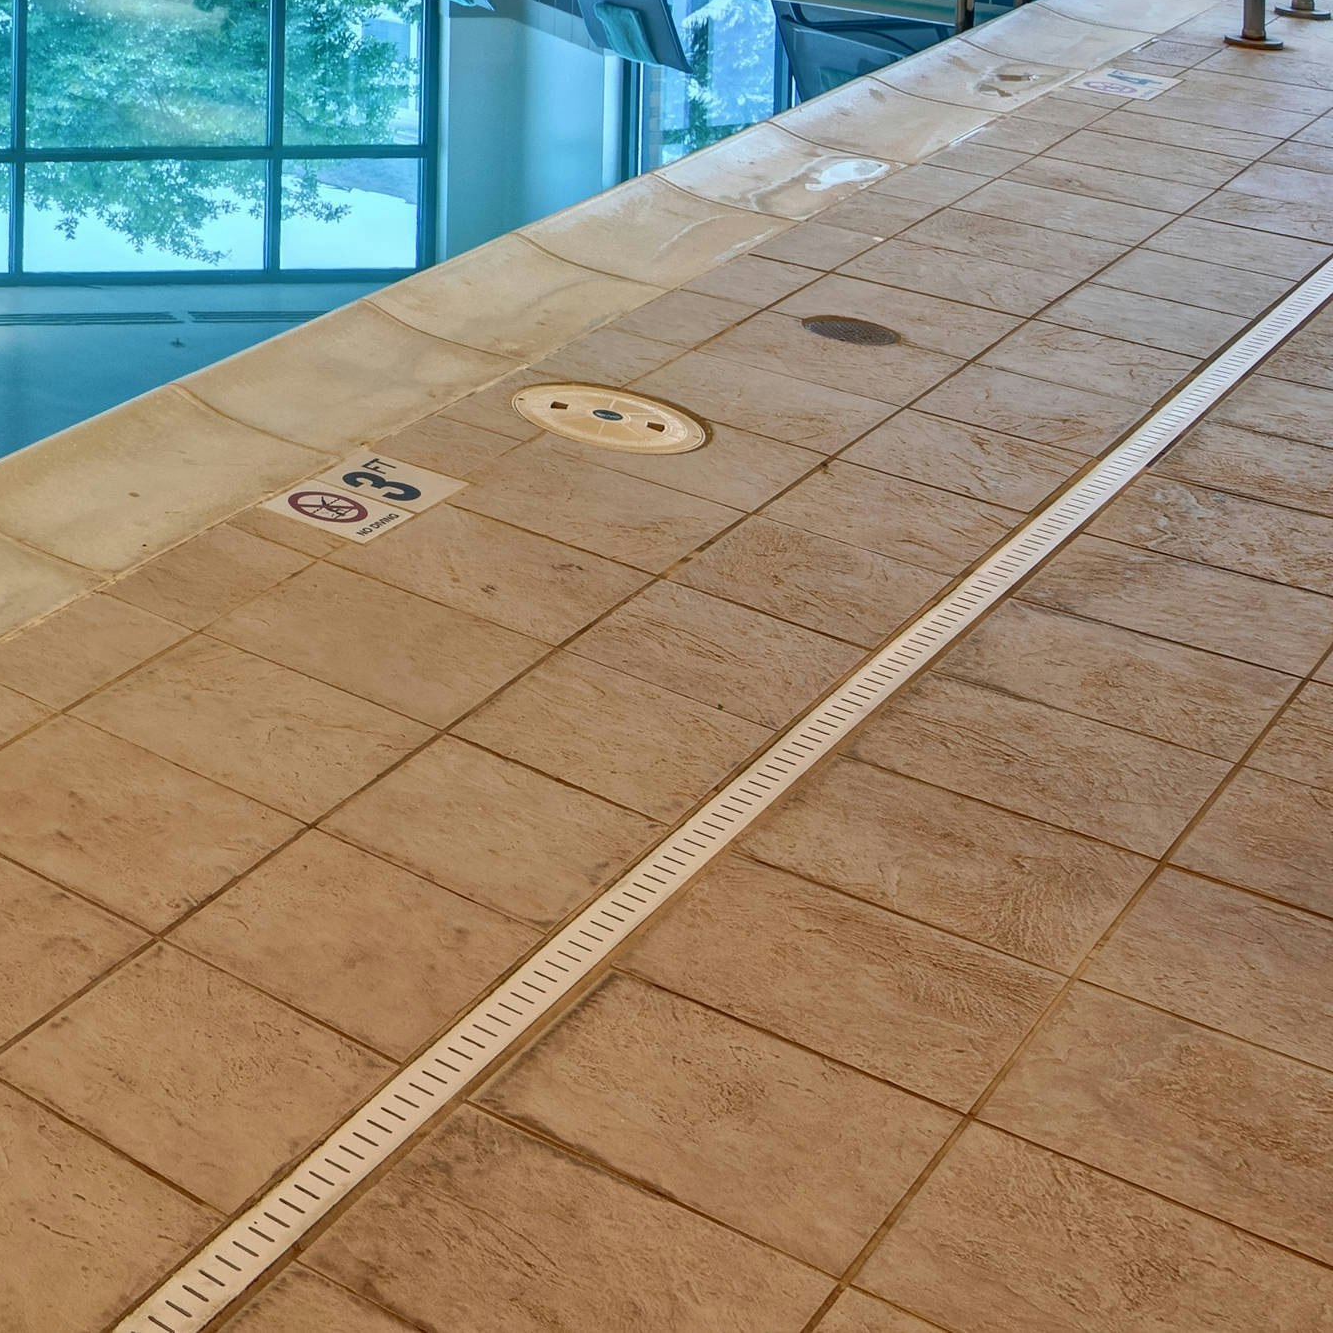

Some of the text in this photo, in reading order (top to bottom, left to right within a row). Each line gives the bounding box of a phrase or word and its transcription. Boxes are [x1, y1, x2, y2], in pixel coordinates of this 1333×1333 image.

[342, 457, 422, 501] 3 FT
[356, 513, 400, 537] NO DIVING
